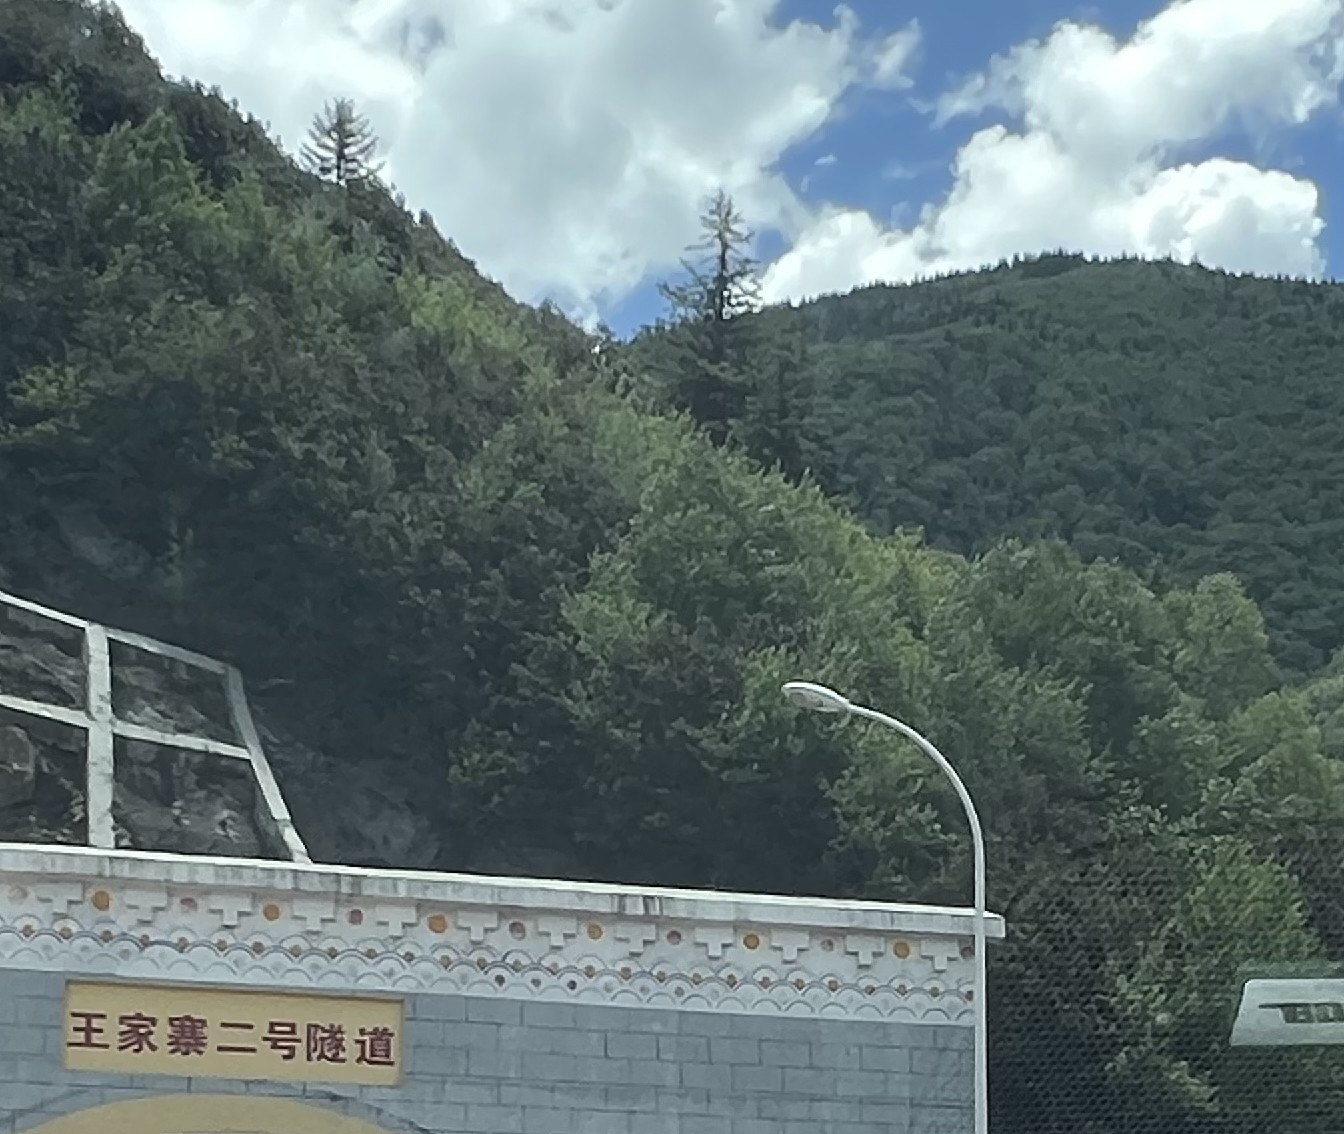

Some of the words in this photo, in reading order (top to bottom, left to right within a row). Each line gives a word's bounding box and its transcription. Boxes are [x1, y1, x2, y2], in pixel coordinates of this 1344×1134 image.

[66, 1011, 396, 1067] 王家寨二号隧道
